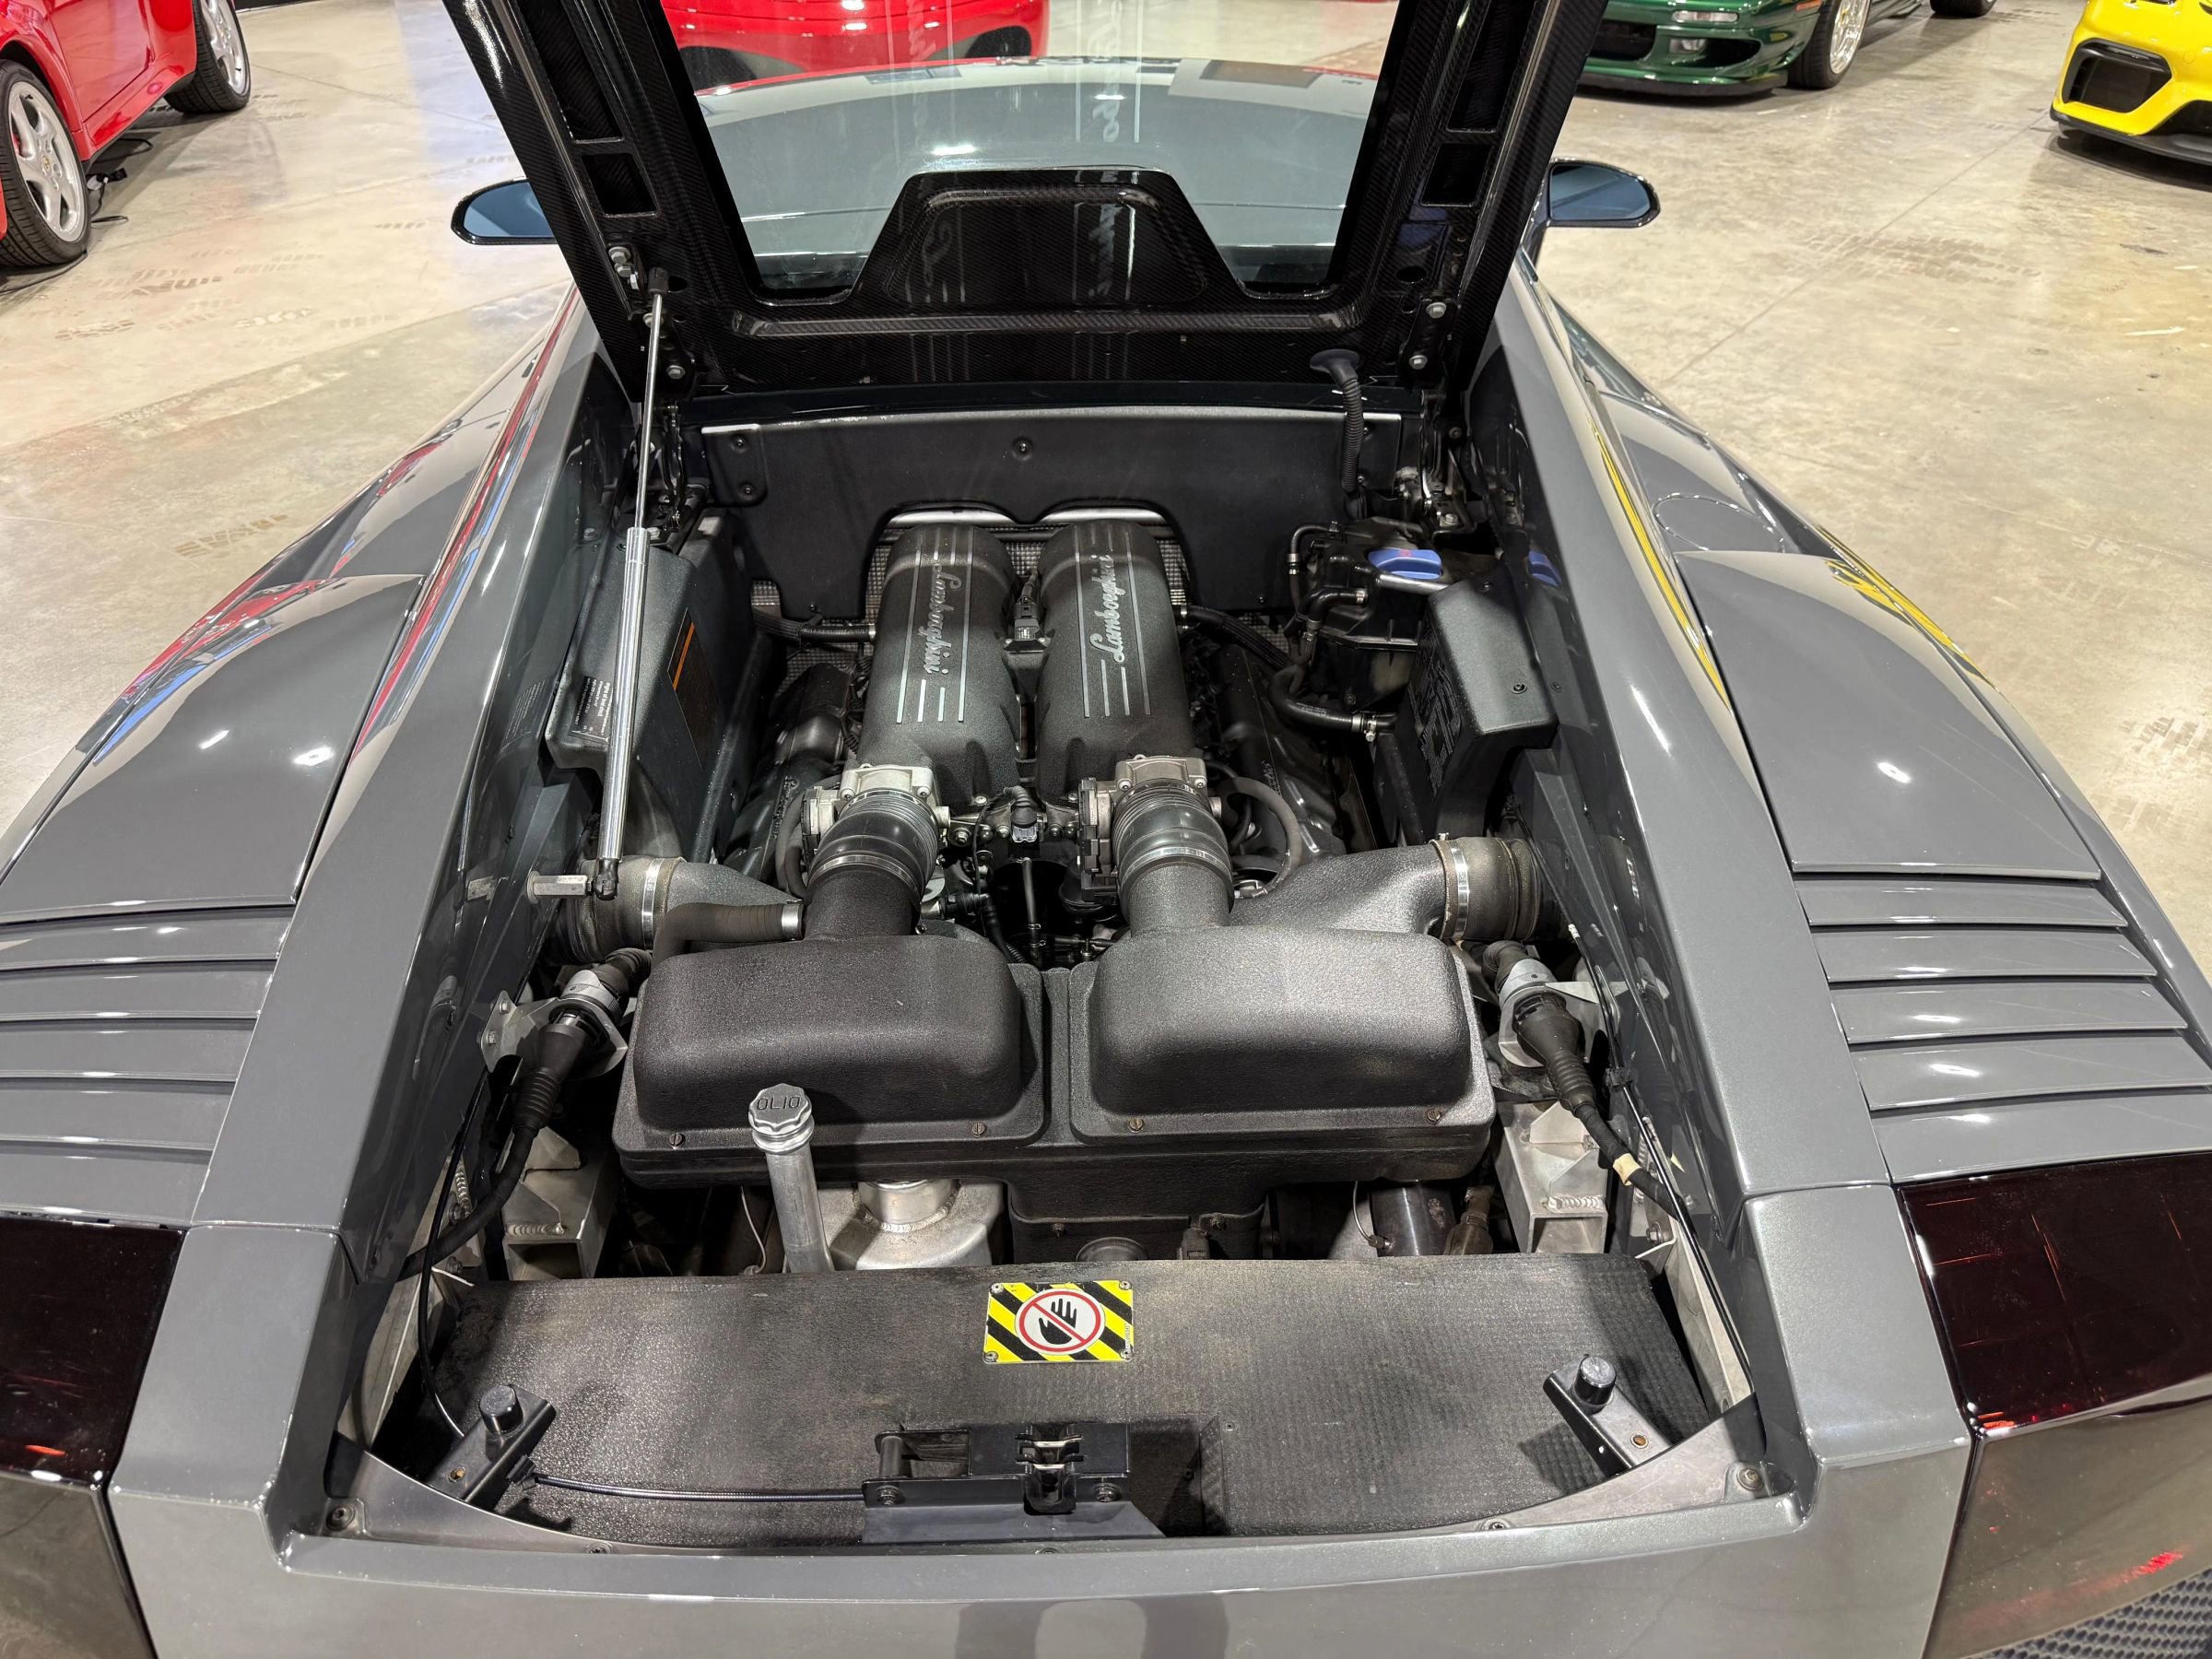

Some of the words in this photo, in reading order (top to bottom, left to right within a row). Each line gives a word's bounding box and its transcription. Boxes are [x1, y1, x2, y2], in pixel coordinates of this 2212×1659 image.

[918, 563, 962, 675] Lamborghini
[1089, 554, 1126, 663] Lamborghini
[757, 1095, 801, 1111] OLIO
